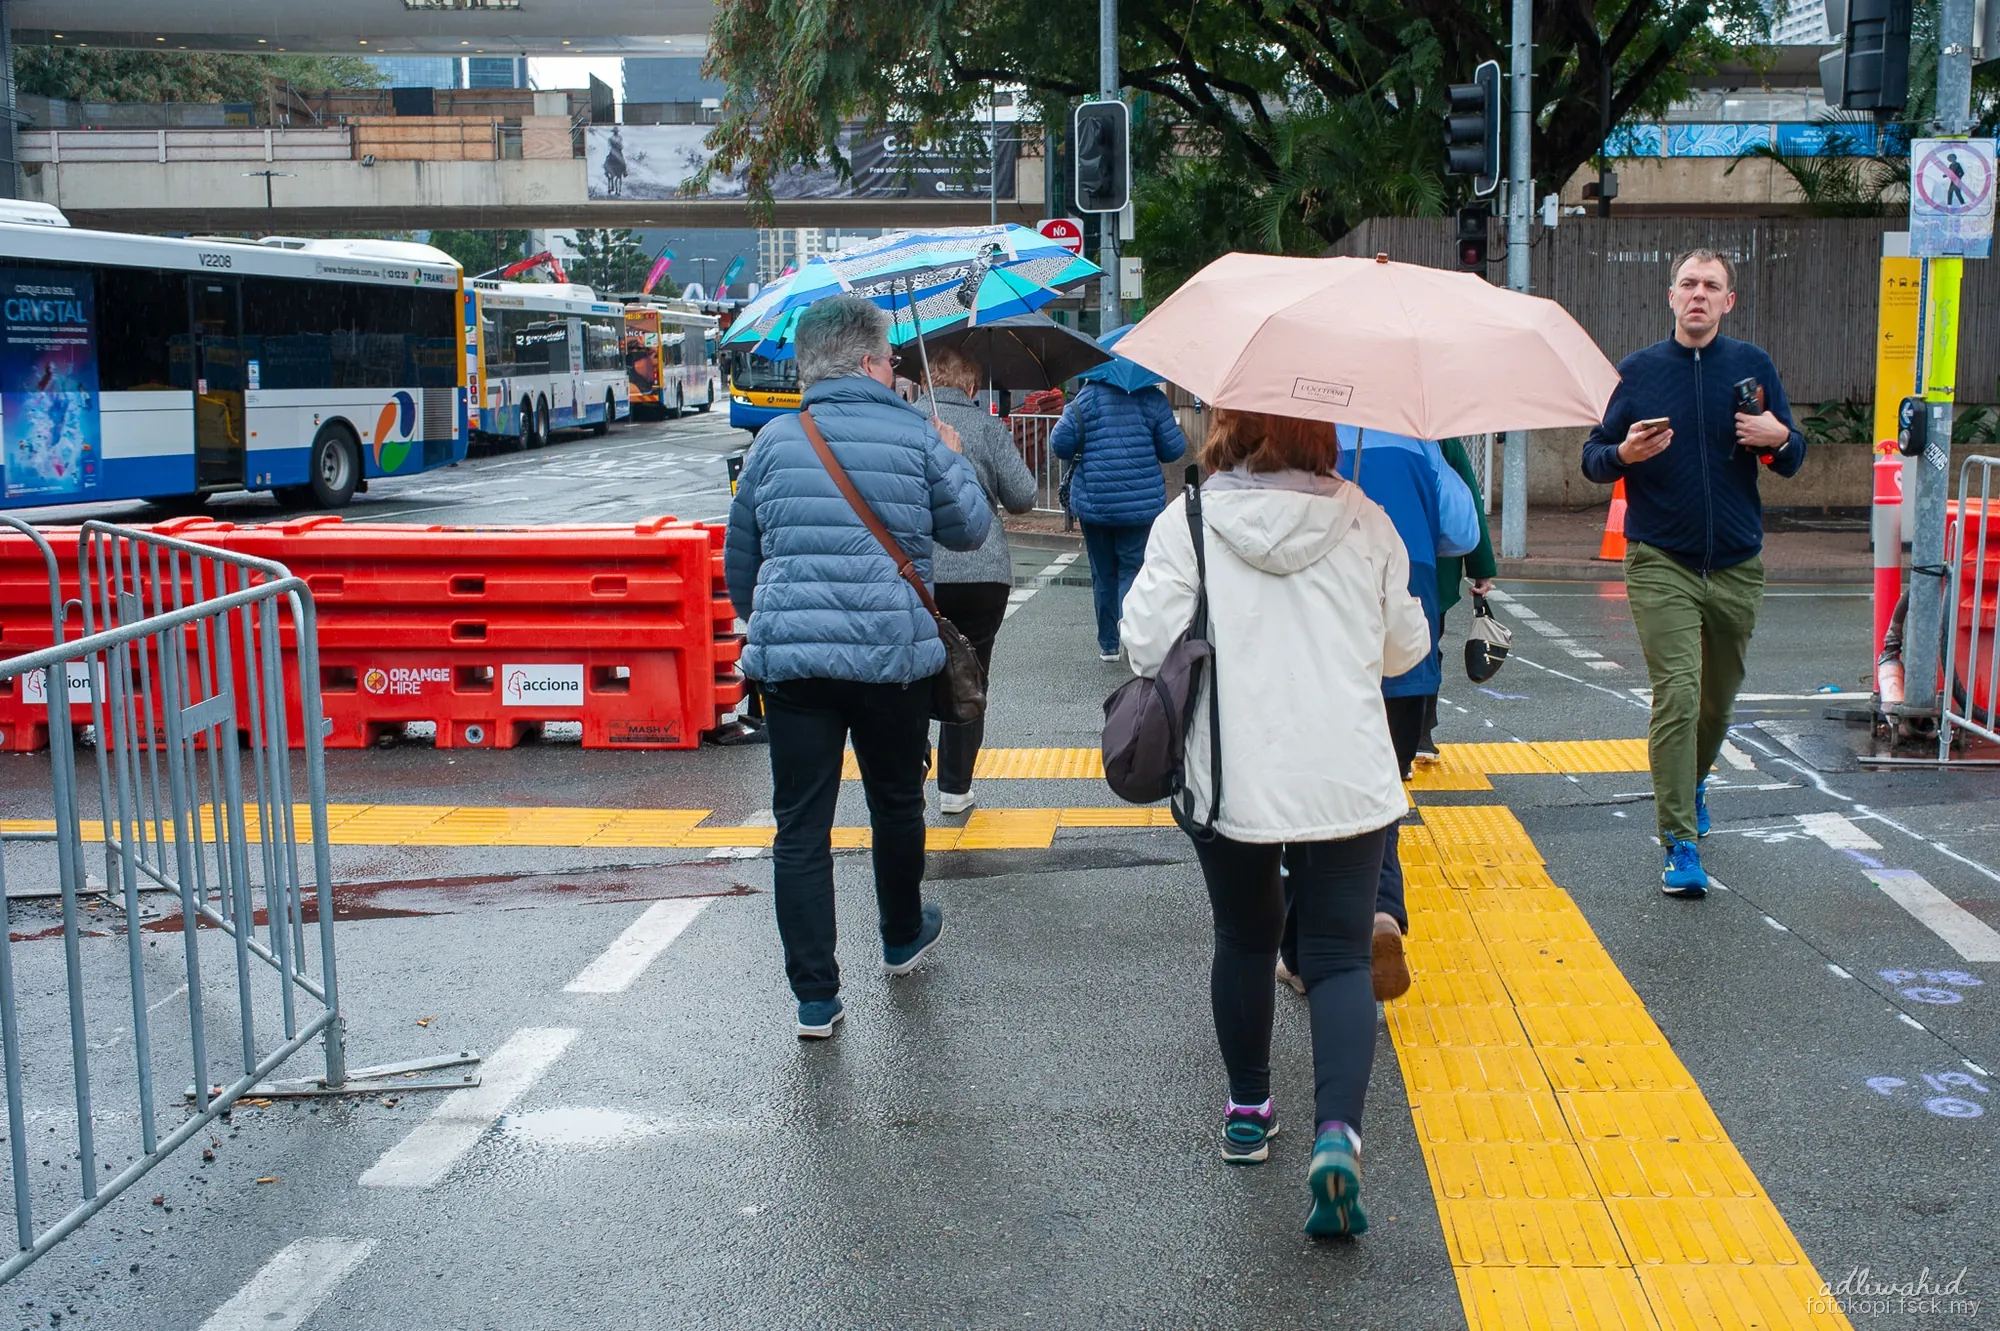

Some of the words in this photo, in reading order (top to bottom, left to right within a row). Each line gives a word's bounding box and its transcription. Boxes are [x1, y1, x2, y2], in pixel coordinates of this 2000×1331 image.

[1053, 226, 1067, 236] NO
[199, 253, 232, 268] V2208
[4, 298, 88, 323] CRYSTAL
[43, 674, 91, 688] aion
[389, 668, 450, 682] ORANGE
[389, 681, 421, 695] HIRE
[523, 677, 579, 691] acciona
